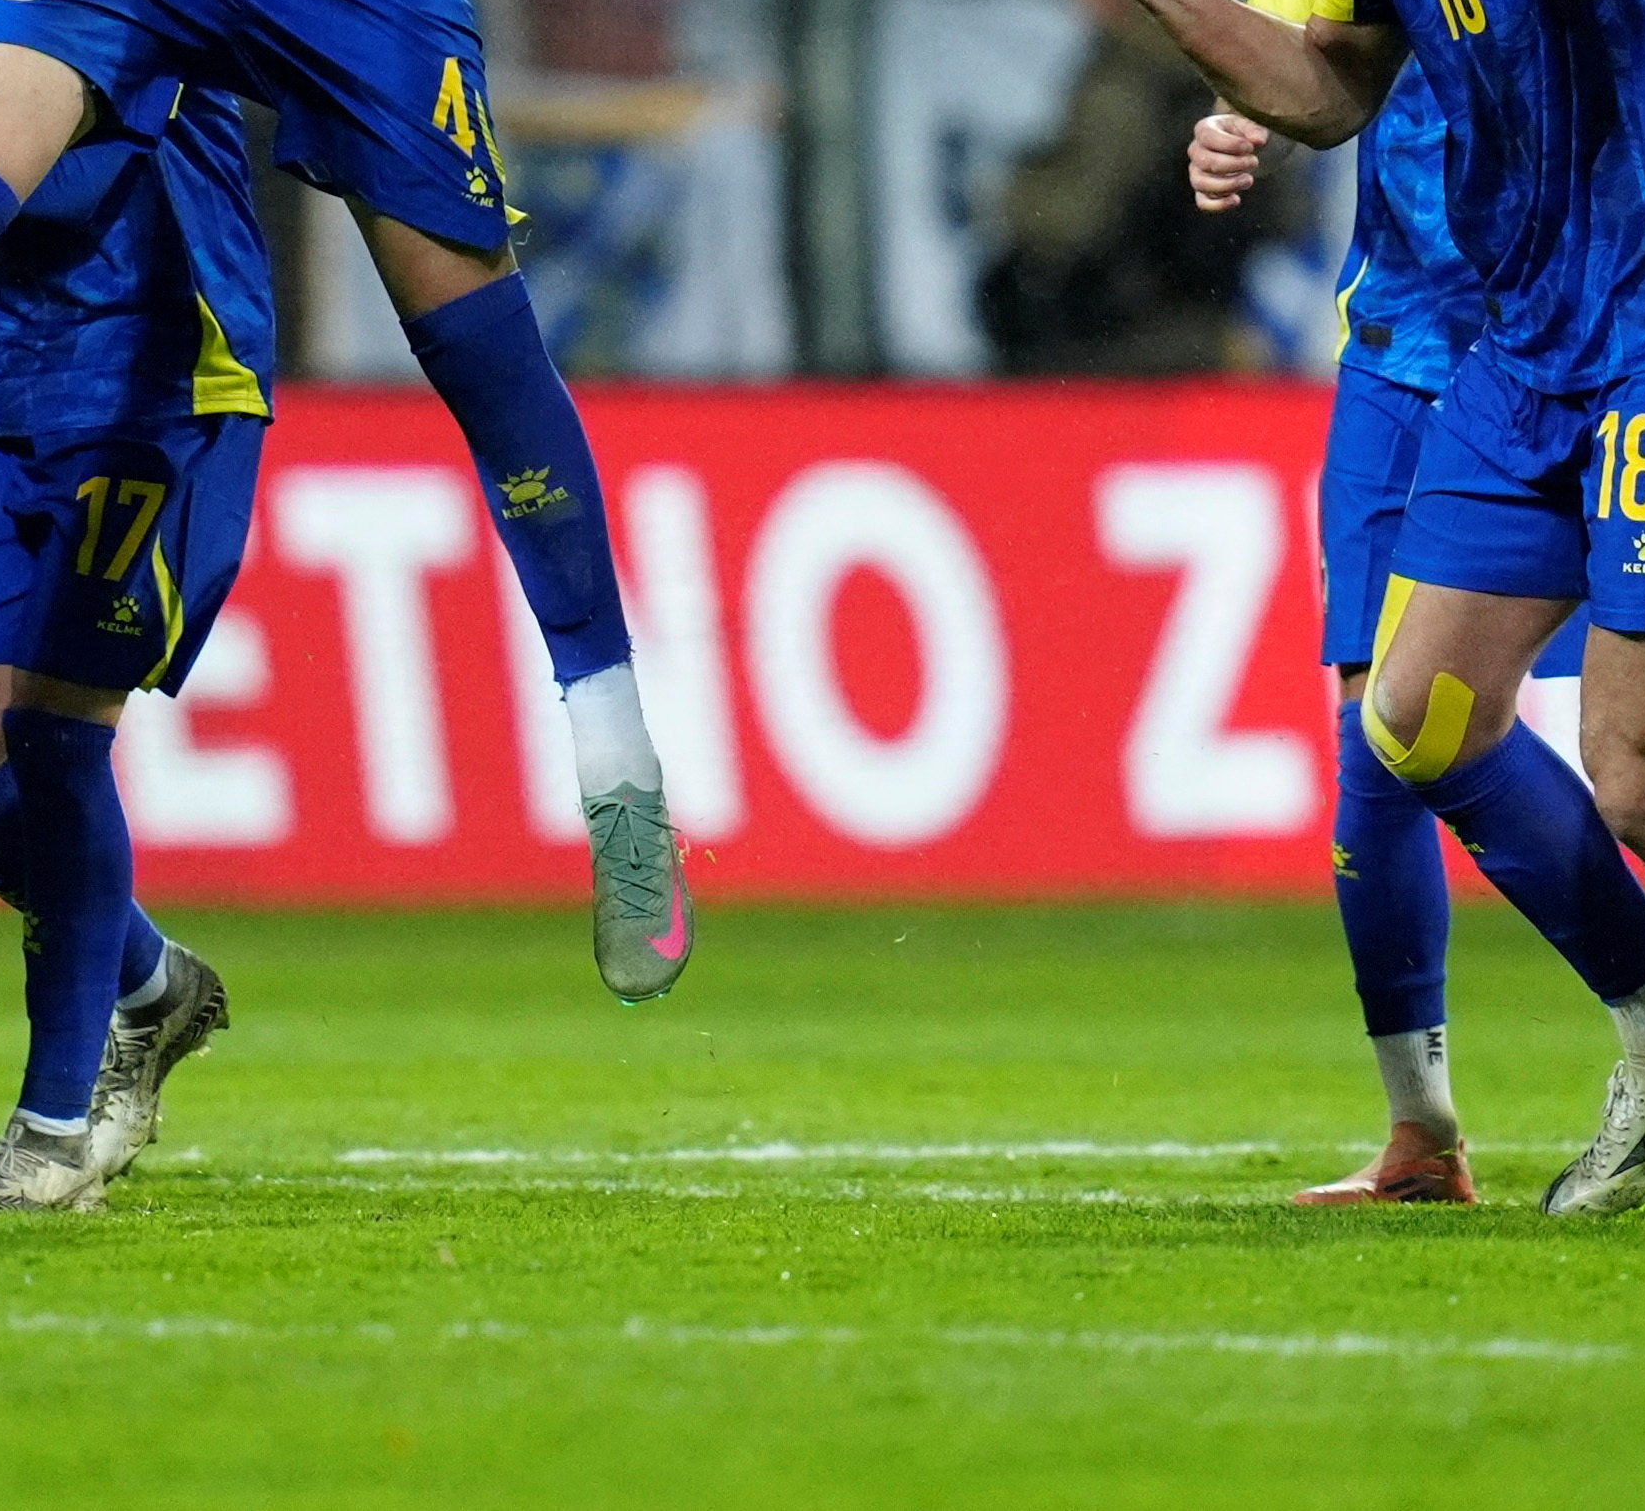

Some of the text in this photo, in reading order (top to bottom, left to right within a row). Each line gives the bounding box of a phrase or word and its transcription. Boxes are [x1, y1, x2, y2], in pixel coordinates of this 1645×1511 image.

[501, 486, 569, 521] KELME
[75, 475, 167, 582] 17
[97, 619, 142, 637] KELME
